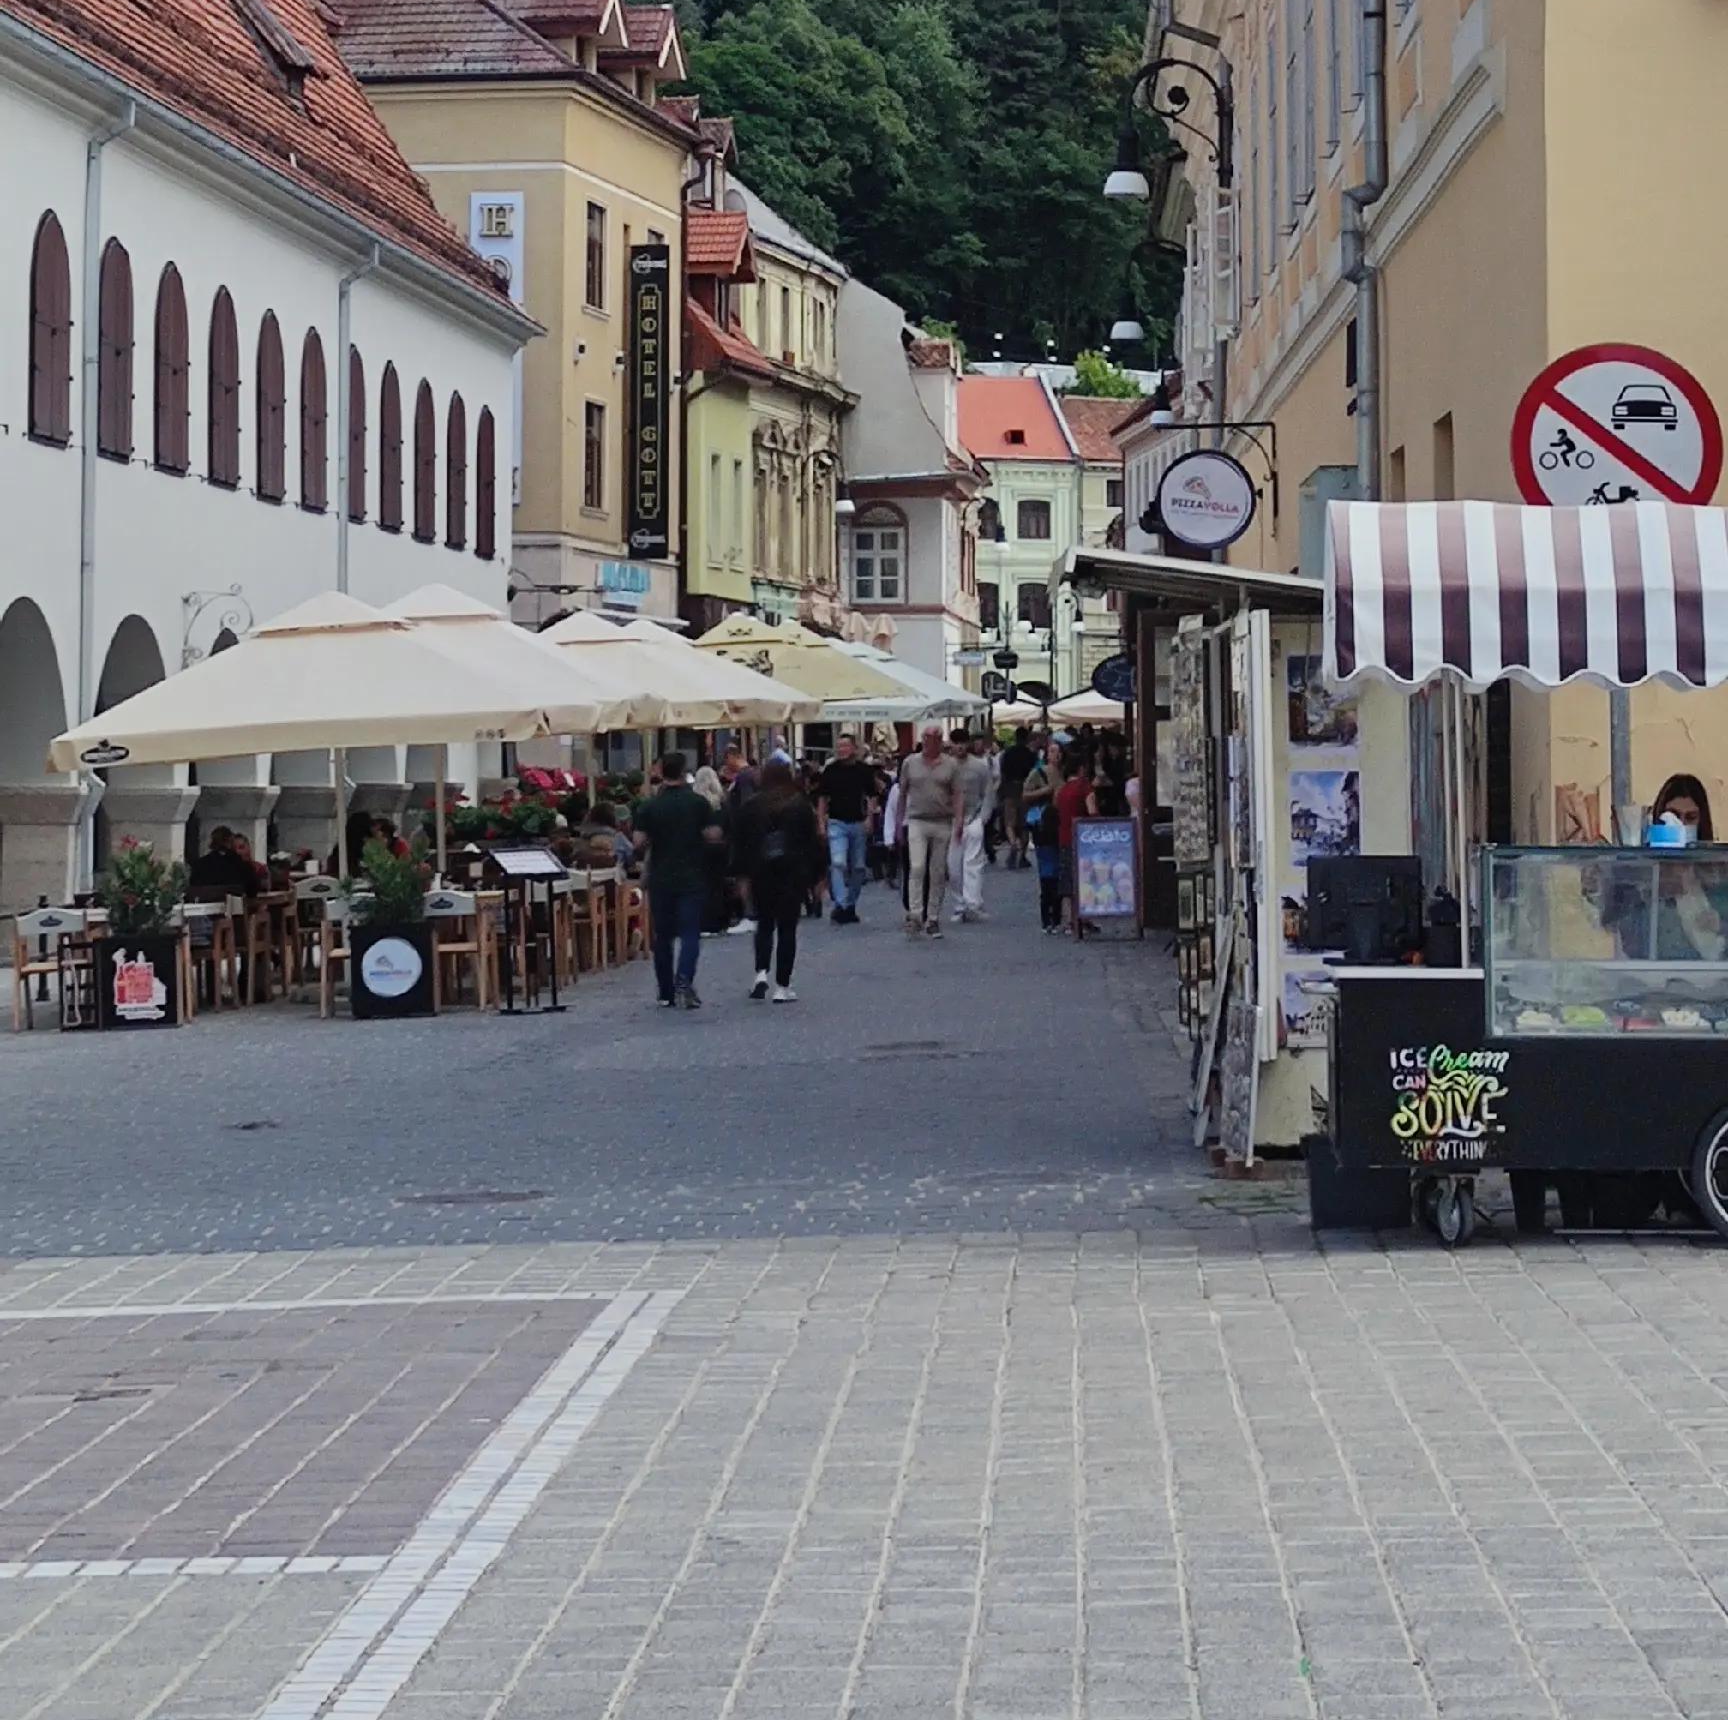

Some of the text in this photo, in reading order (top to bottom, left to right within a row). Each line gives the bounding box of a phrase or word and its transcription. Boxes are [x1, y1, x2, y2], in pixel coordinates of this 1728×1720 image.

[640, 295, 657, 508] HOTEL GOTT
[1389, 1044, 1510, 1073] ICE Cream
[1392, 1074, 1427, 1091] CAN
[1391, 1075, 1509, 1138] SOLVE
[1412, 1140, 1490, 1160] EVERYTHIN
